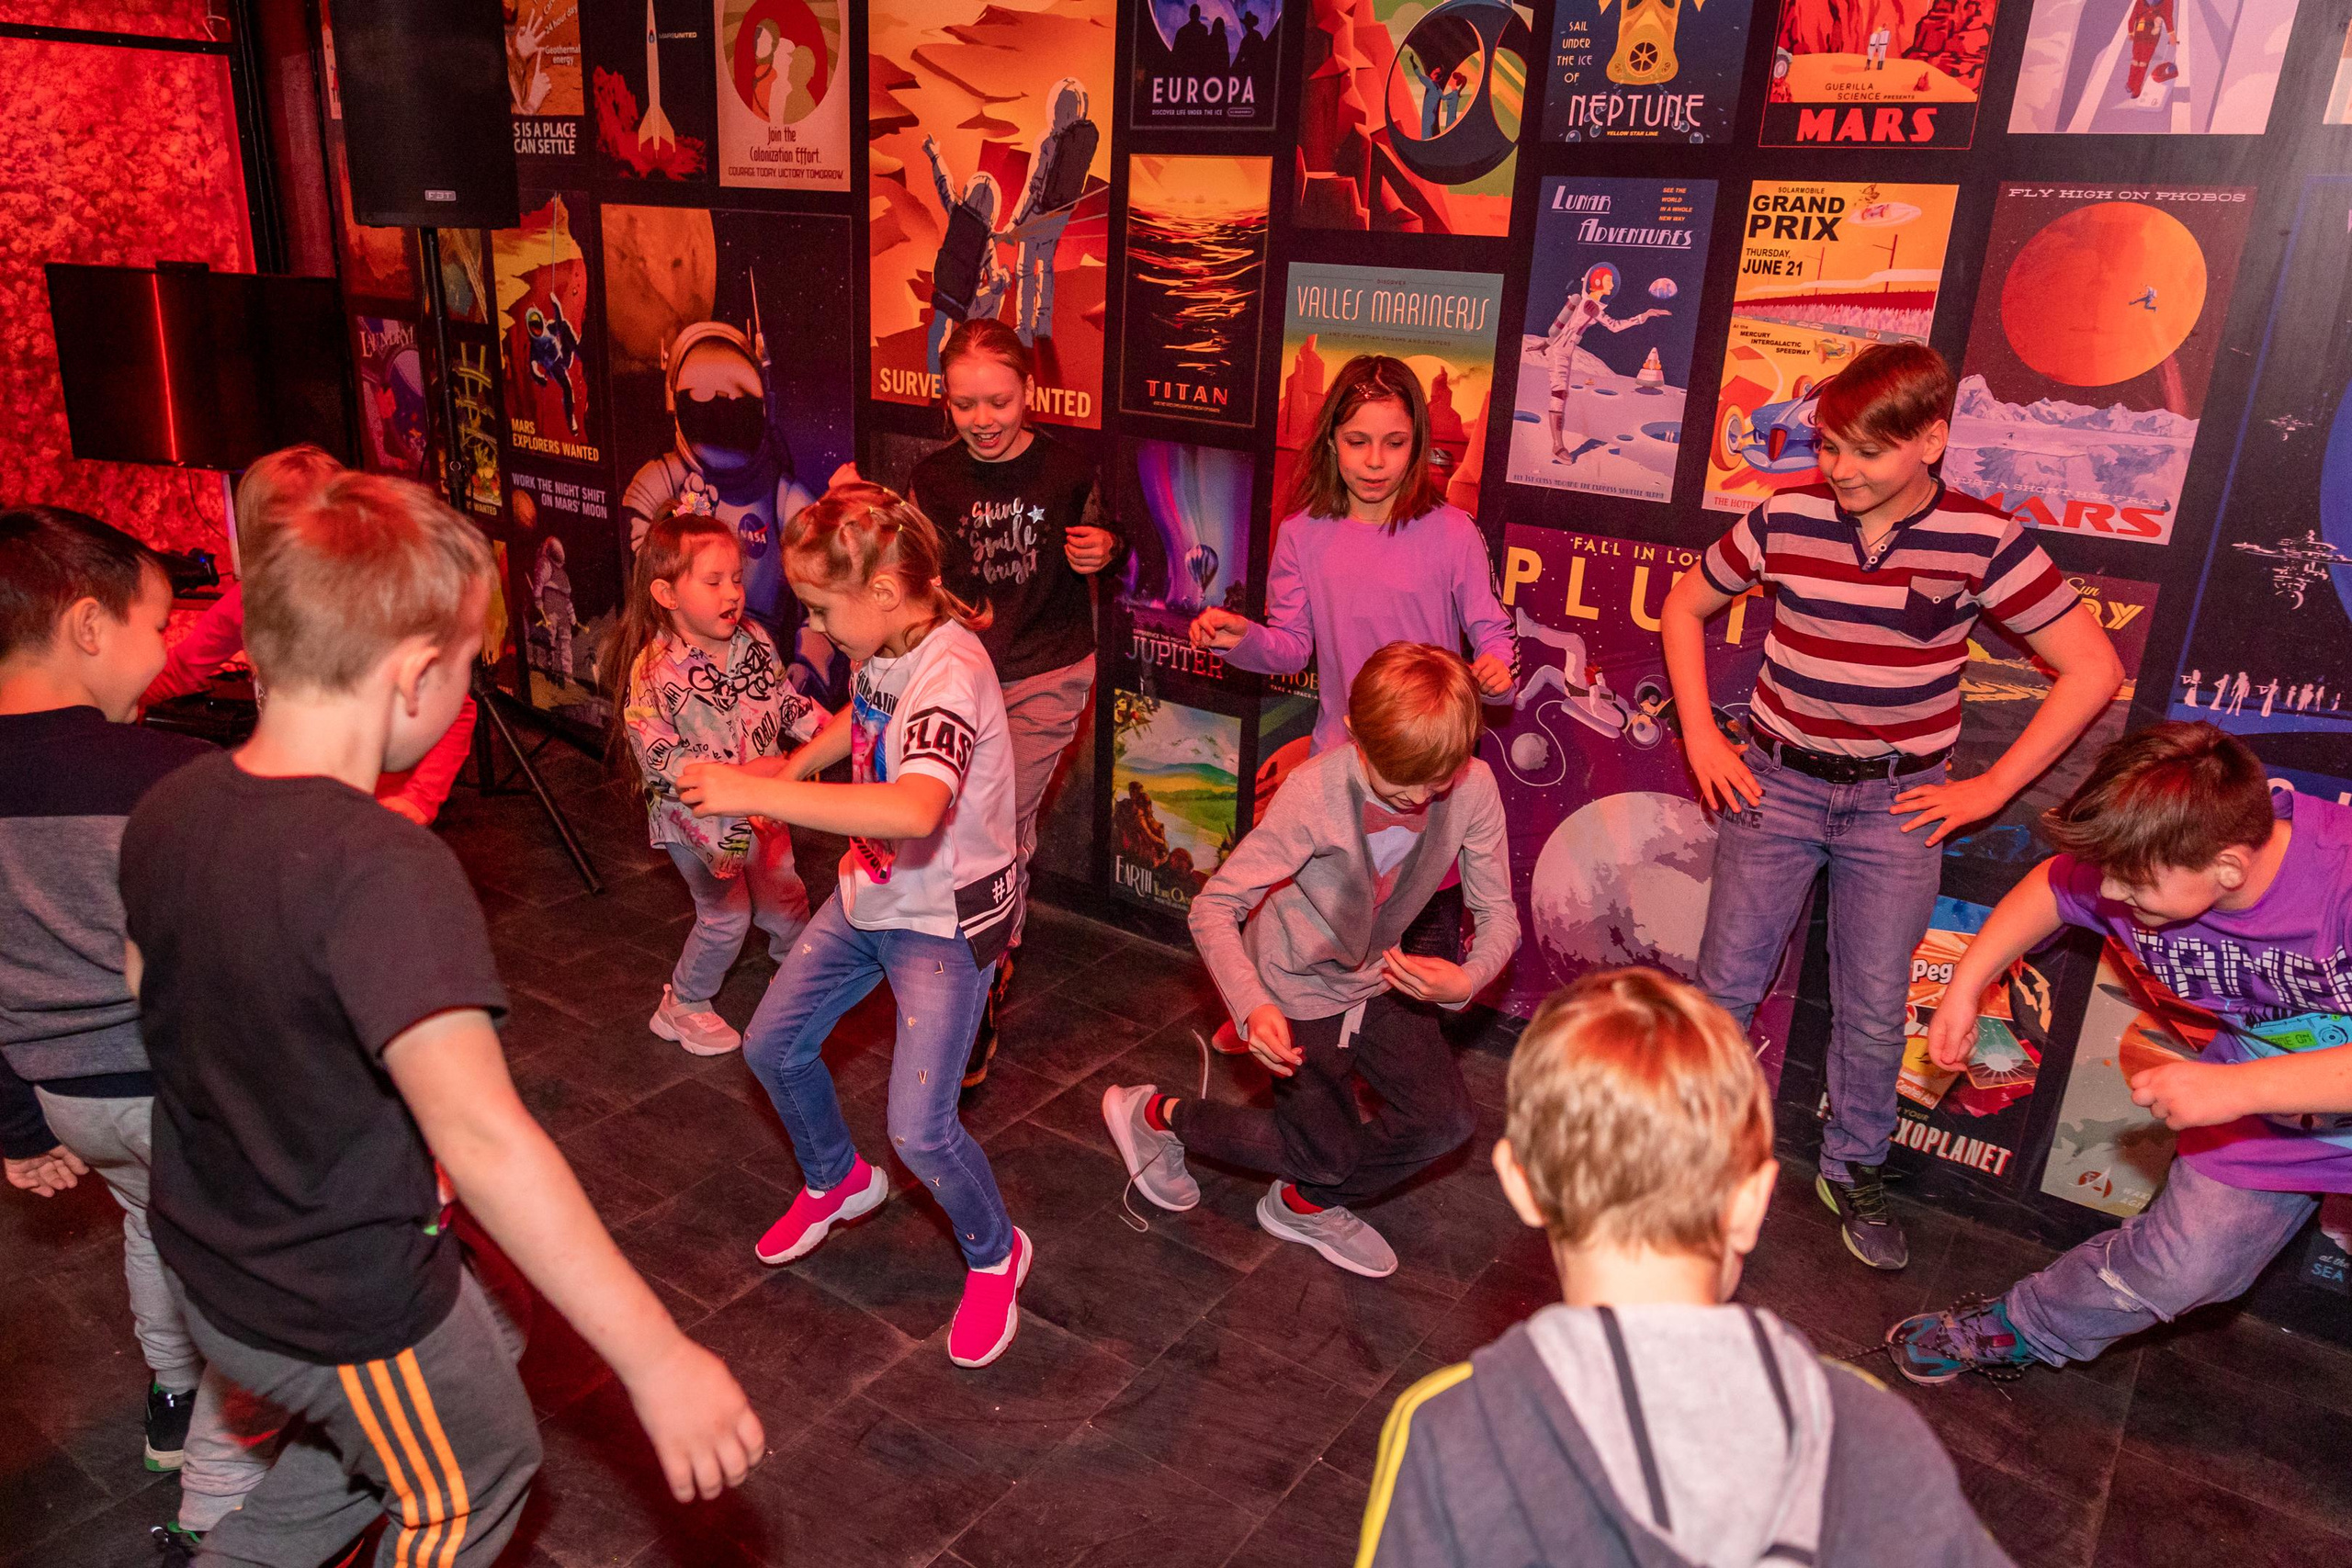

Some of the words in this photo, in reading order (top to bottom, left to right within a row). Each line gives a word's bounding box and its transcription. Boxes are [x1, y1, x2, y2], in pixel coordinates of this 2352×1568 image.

[1568, 21, 1588, 32] SAIL
[545, 45, 581, 54] Geothermal
[1562, 38, 1591, 49] UNDER
[552, 55, 574, 65] energy
[1556, 55, 1575, 66] THE
[1577, 55, 1593, 65] ICE
[1564, 73, 1580, 84] OF
[1152, 75, 1255, 104] EUROPA
[1825, 83, 1873, 91] GUERILLA
[1568, 95, 1704, 127] NEPTUNE
[522, 122, 532, 137] IS
[534, 123, 541, 137] A
[543, 122, 577, 138] PLACE
[1796, 107, 1938, 142] MARS
[767, 126, 781, 145] Join
[784, 127, 796, 142] the
[514, 139, 536, 153] CAN
[538, 139, 576, 154] SETTLE
[750, 146, 793, 163] Colonization
[729, 166, 755, 176] COURAGE
[1778, 186, 1826, 195] SOLARMOBILE
[2008, 188, 2054, 197] FLY
[2058, 189, 2114, 199] HIGH
[2119, 191, 2151, 200] ON
[2155, 191, 2247, 203] PHOBOS
[1753, 195, 1846, 214] GRAND
[1747, 214, 1843, 242] PRIX
[1746, 247, 1791, 259] THURSDAY,
[1742, 259, 1782, 276] JUNE
[1785, 261, 1803, 276] 21
[1296, 285, 1364, 321] VALLES
[1371, 290, 1491, 331] MARINERIS
[1751, 339, 1802, 347] INTERGALACTIC
[1776, 347, 1811, 355] SPEEDWAY
[1146, 379, 1227, 406] TITAN
[512, 418, 536, 434] MARS
[513, 434, 560, 455] EXPLORERS
[562, 443, 599, 462] WANTED
[512, 473, 536, 490] WORK
[537, 478, 553, 492] THE
[555, 480, 580, 499] NIGHT
[582, 487, 606, 504] SHIFT
[1996, 481, 2009, 490] A
[2014, 483, 2072, 497] SHORT
[2076, 491, 2109, 500] HOP
[2112, 496, 2169, 507] FROM
[541, 493, 553, 506] ON
[582, 504, 607, 519] MOON
[1714, 497, 1729, 506] THE
[474, 504, 497, 516] WANTED
[741, 529, 766, 544] NASA
[1574, 536, 1622, 556] FALL
[1634, 546, 1655, 560] IN
[1667, 550, 1701, 566] LO
[1125, 636, 1224, 679] JUPITER
[1115, 854, 1153, 897] EARTH
[1905, 1108, 1929, 1122] YOUR
[1888, 1116, 2014, 1177] XOPLANET
[2311, 1262, 2345, 1283] SEA
